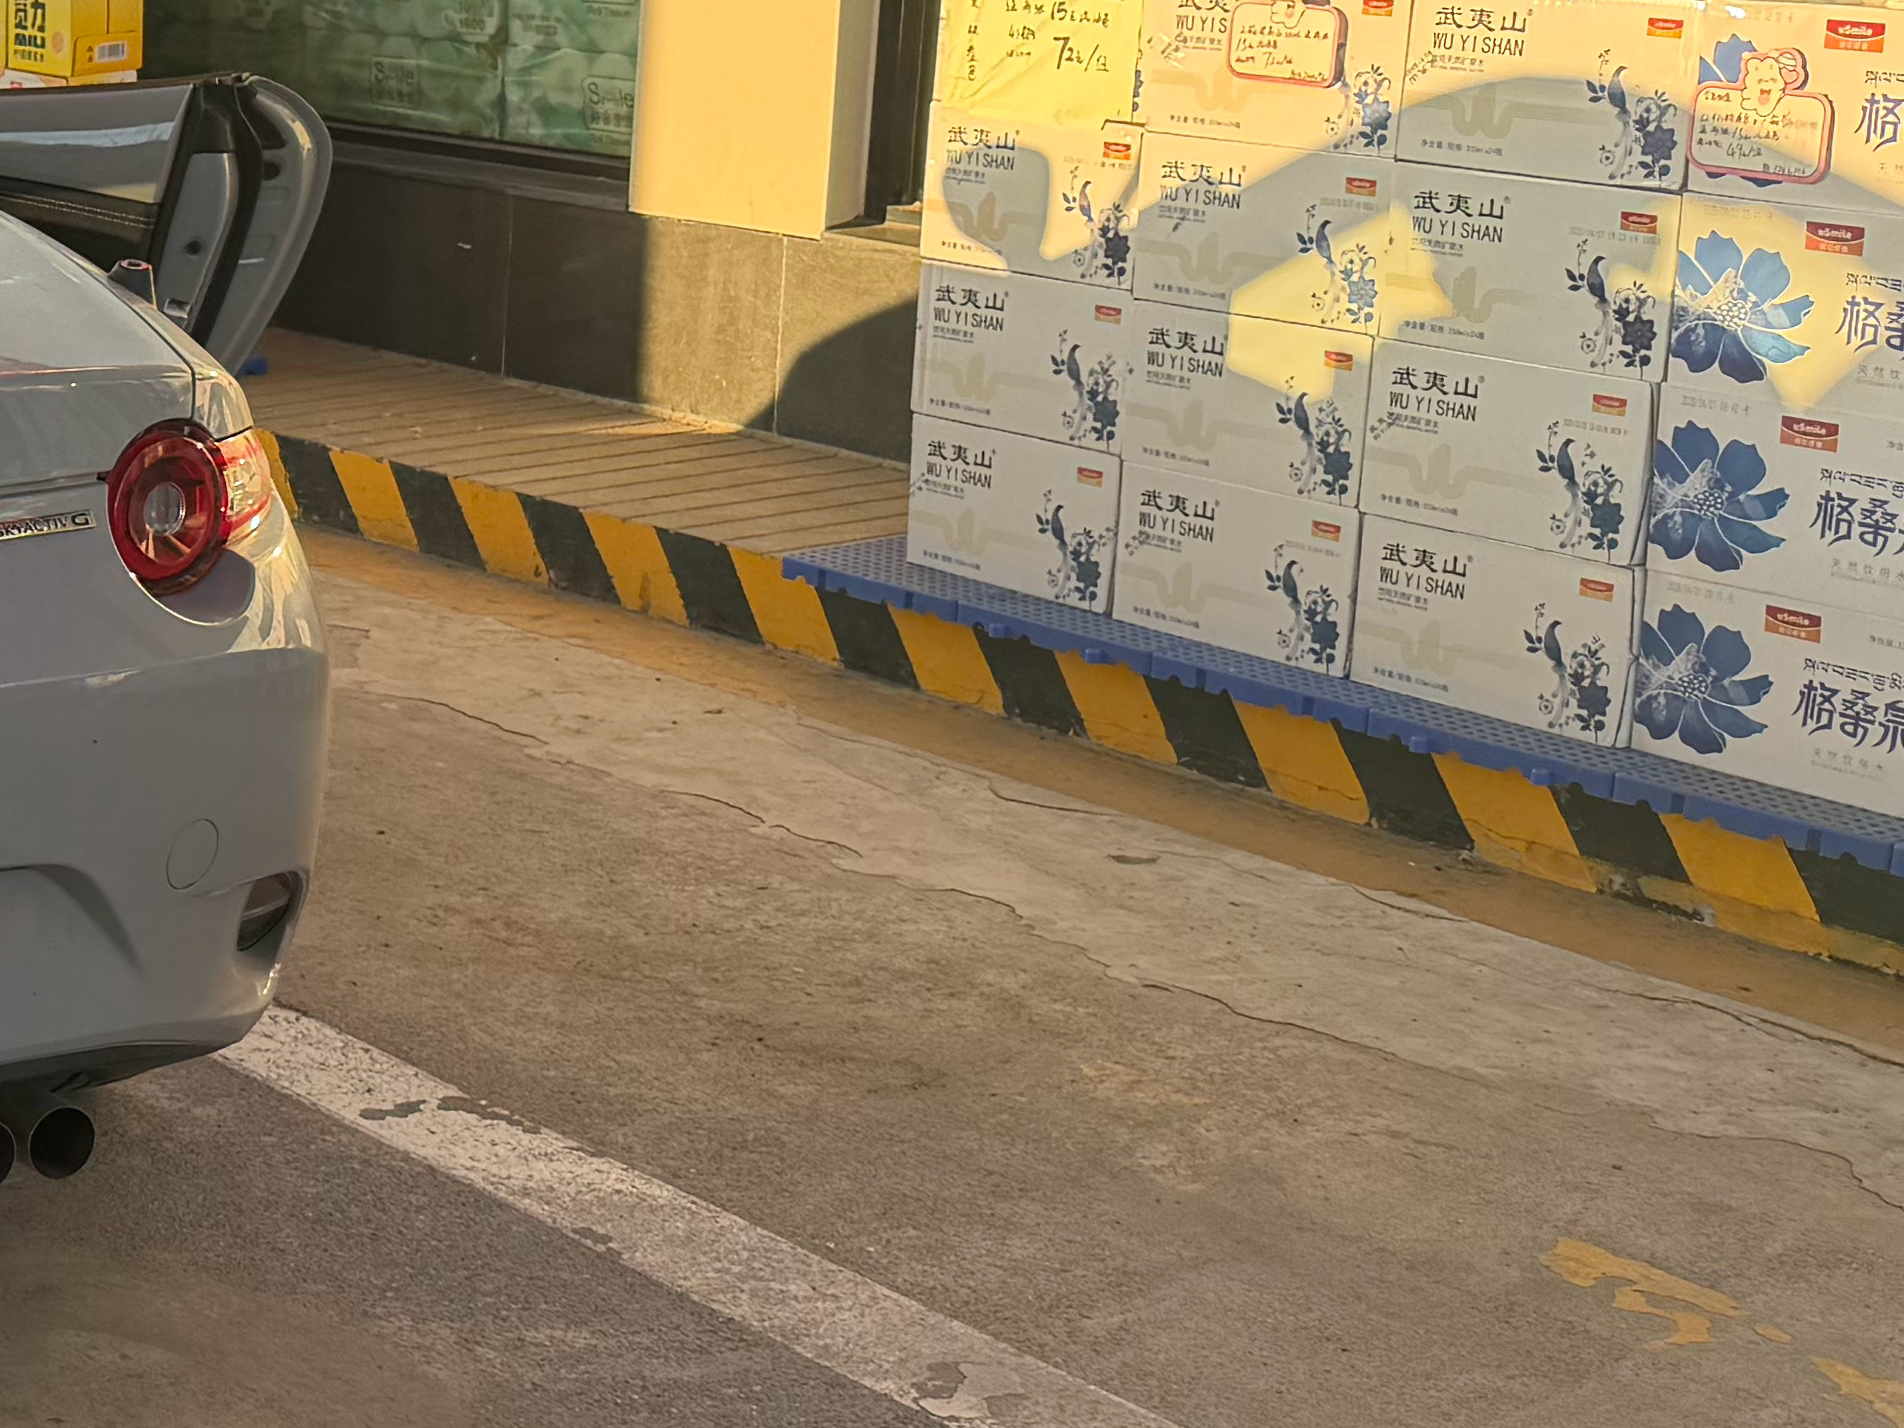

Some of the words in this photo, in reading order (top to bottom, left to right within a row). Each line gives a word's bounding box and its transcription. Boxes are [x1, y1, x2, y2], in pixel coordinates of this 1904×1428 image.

[1435, 6, 1527, 33] 武夷山
[1854, 93, 1904, 152] 格
[948, 126, 1015, 150] 武夷山
[1162, 160, 1242, 187] 武夷山
[1414, 190, 1504, 220] 武夷山
[936, 285, 1005, 312] 武夷山
[1148, 327, 1224, 357] 武夷山
[1392, 366, 1479, 399] 武夷山
[927, 440, 992, 469] 武夷山
[71, 513, 89, 526] G
[1140, 489, 1215, 522] 武夷山
[1809, 490, 1904, 557] 格桑
[1381, 542, 1467, 578] 武夷山
